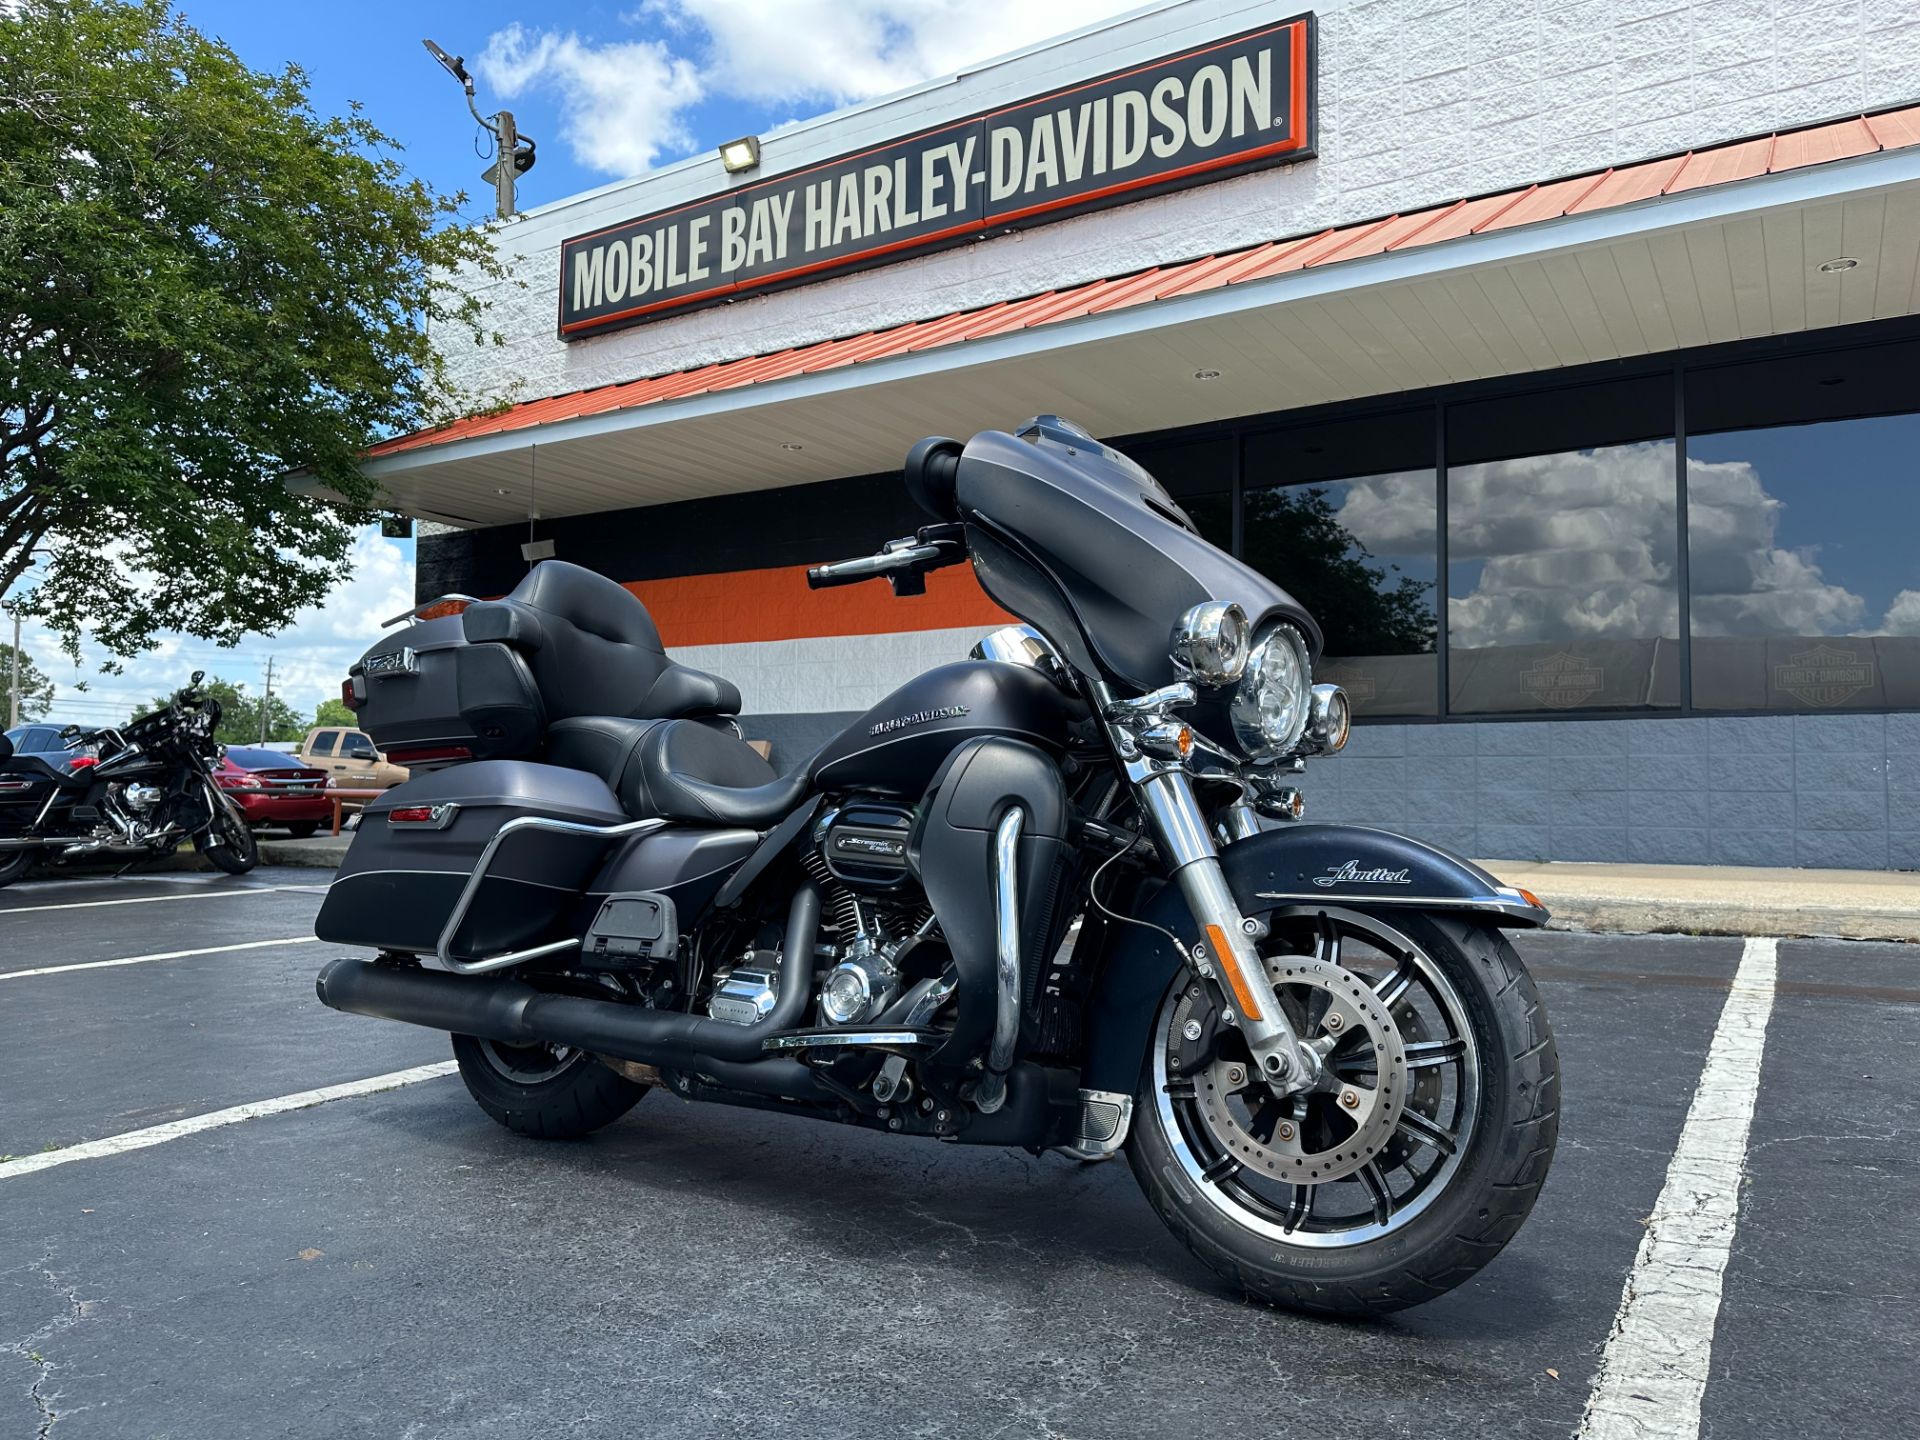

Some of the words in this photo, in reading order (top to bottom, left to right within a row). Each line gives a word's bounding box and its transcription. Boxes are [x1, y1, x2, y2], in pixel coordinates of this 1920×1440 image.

[573, 215, 711, 312] MOBILE
[721, 190, 795, 274] BAY
[805, 48, 1271, 253] HARLEY-DAVIDSON
[1783, 669, 1865, 684] HARLEY-DAVIDSON
[1313, 859, 1412, 887] Limited
